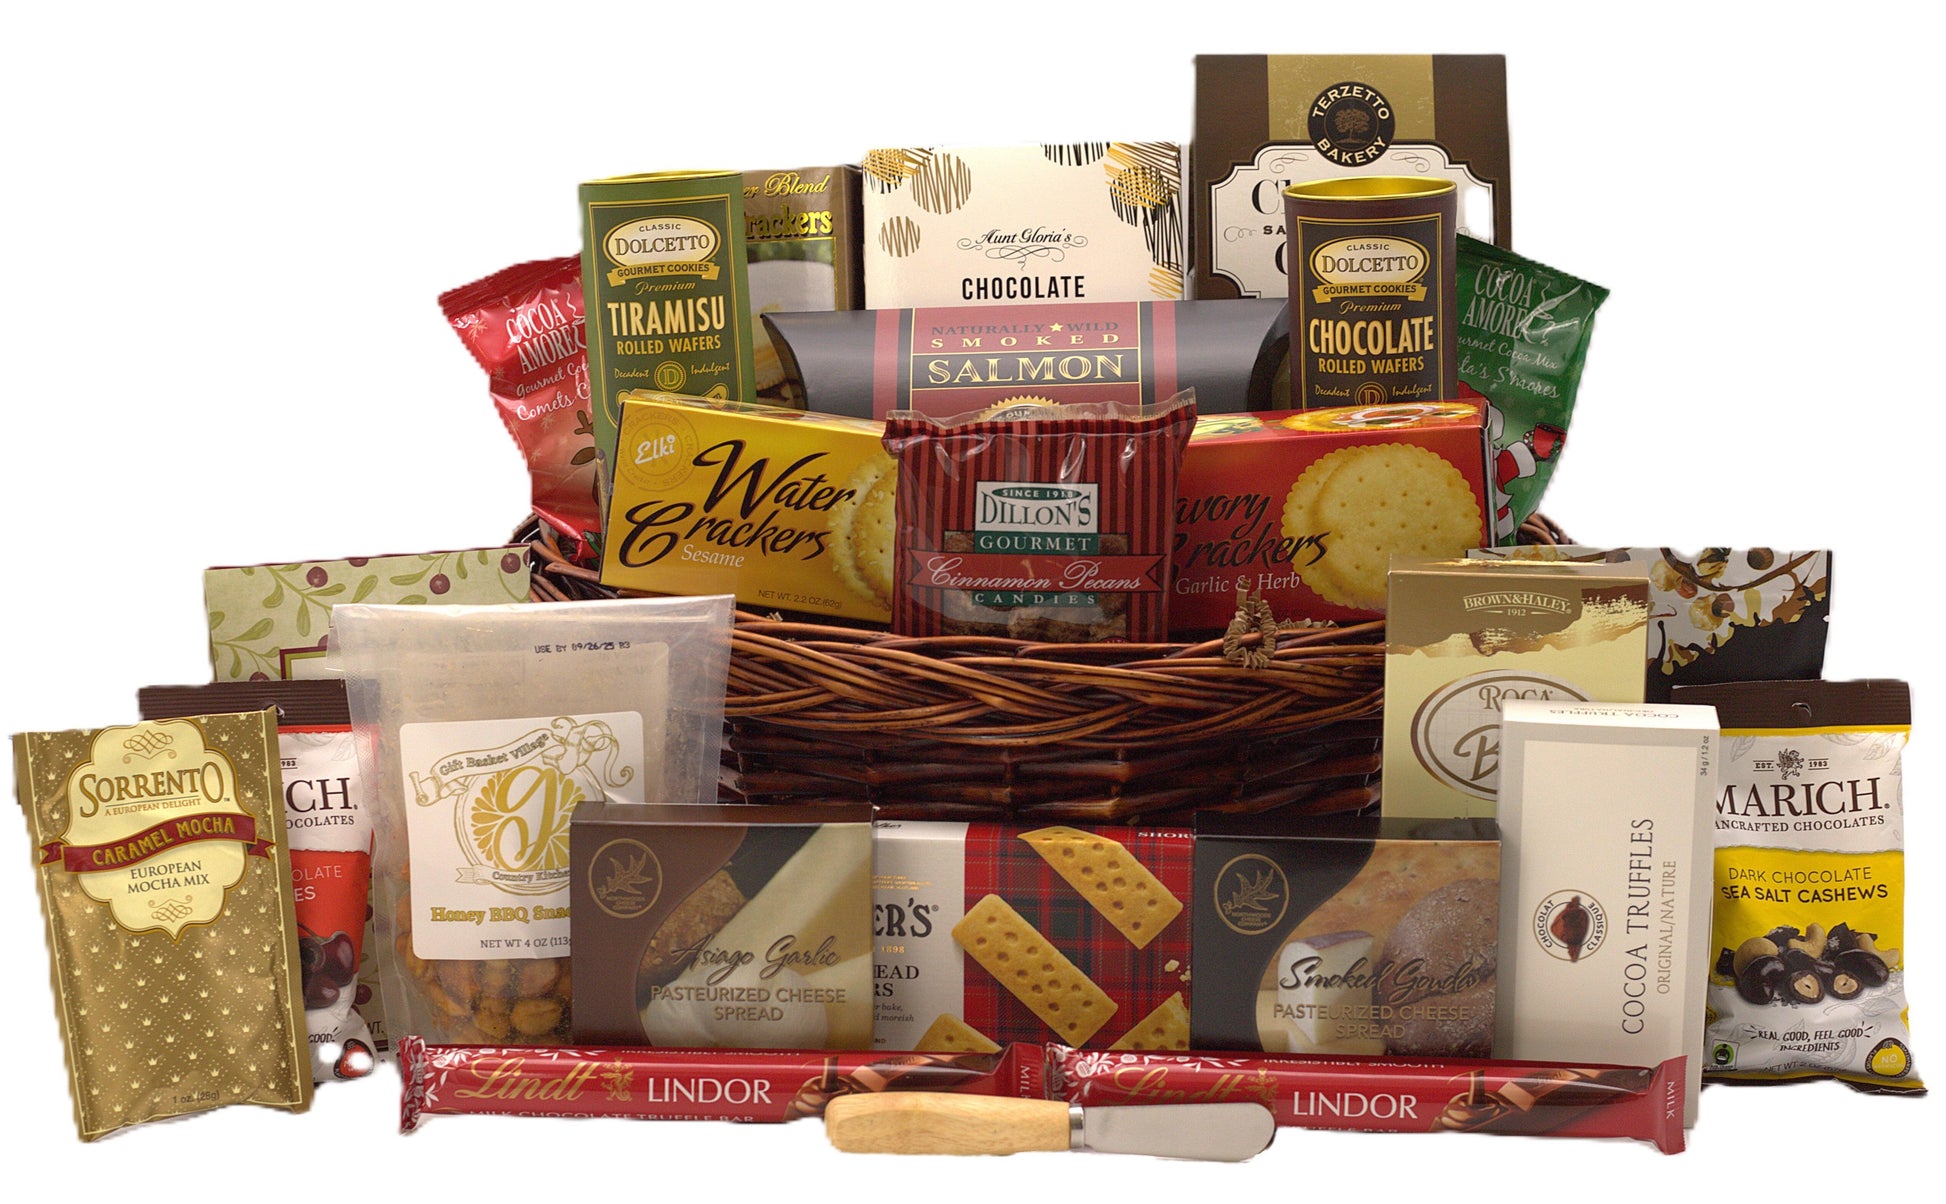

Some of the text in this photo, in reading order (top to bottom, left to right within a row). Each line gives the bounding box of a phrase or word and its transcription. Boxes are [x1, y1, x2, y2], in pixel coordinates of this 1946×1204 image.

[1312, 85, 1390, 121] TERZETTO
[1317, 136, 1387, 164] BAKERY
[764, 172, 831, 196] Blend
[639, 223, 682, 232] CLASSIC
[744, 203, 833, 238] rackers
[615, 234, 710, 256] DOLCETTO
[975, 226, 1072, 245] Aunt Gloria's
[1346, 243, 1390, 252] CLASSIC
[617, 263, 710, 278] GOURMET COOKIES
[1322, 255, 1418, 274] DOLCETTO
[635, 281, 696, 296] Premium
[962, 276, 1085, 300] CHOCOLATE
[1323, 284, 1417, 295] GOURMET COOKIES
[1474, 264, 1534, 308] COCOA
[607, 296, 725, 337] TIRAMISU
[1339, 300, 1402, 315] Premium
[1462, 296, 1529, 340] AMORE
[506, 299, 567, 340] COCOA
[932, 321, 1119, 336] NATURALLY WILD
[617, 335, 722, 355] ROLLED WAFERS
[930, 333, 1119, 348] SMOKED
[1309, 315, 1435, 356] CHOCOLATE
[518, 324, 579, 374] AMORE
[614, 368, 650, 379] Decadent
[691, 362, 730, 376] Indulgent
[928, 354, 1124, 384] SALMON
[1318, 356, 1425, 375] ROLLED WAFERS
[516, 368, 566, 399] Gourmet
[1314, 384, 1350, 397] Decadent
[1392, 384, 1432, 398] Indulgent
[516, 392, 576, 421] Comets
[635, 434, 676, 465] Elki
[692, 439, 857, 520] Water
[1002, 488, 1040, 498] SINCE
[980, 491, 1092, 527] DILLON'S
[1175, 493, 1271, 541] avory
[619, 499, 833, 568] Crackers
[979, 535, 1092, 551] GOURMET
[681, 544, 745, 568] Sesame
[927, 556, 1142, 590] Cinnamon Pecans
[1176, 575, 1229, 595] Garlic
[1257, 571, 1300, 591] Herb
[758, 589, 774, 599] NET
[777, 592, 790, 601] WT.
[793, 594, 807, 604] 2.2
[975, 593, 1096, 605] CANDIES
[1507, 608, 1527, 616] 1912
[439, 733, 549, 776] Gift Basket Village
[1809, 760, 1828, 768] 1983
[79, 761, 224, 818] SORRENTO
[1716, 777, 1881, 817] MARICH
[104, 799, 202, 817] A EUROPEAN DELIGHT
[286, 815, 355, 830] OCOLATES
[1715, 815, 1885, 832] ANCRAFTED CHOCOLATES
[92, 817, 236, 866] CARAMEL MOCHA
[130, 861, 202, 880] EUROPEAN
[291, 865, 342, 882] OLATE
[492, 871, 534, 884] Country
[1729, 866, 1872, 884] DARK CHOCOLATE
[127, 873, 210, 895] MOCHA MIX
[1721, 884, 1888, 903] SEA SALT CASHEWS
[431, 906, 486, 925] Honey
[489, 906, 530, 924] BBQ
[1538, 899, 1554, 949] CHOCOLAT
[1586, 901, 1604, 951] CLASSIQUE
[1621, 818, 1654, 1035] COCOA TRUFFLES
[1656, 860, 1677, 995] ORIGINAL/NATURE
[480, 939, 502, 948] NET
[504, 939, 522, 948] WT
[524, 939, 531, 948] 4
[533, 938, 548, 948] OZ
[671, 934, 841, 986] Asiago Garlic
[1279, 956, 1480, 1009] Smoked Gouda
[651, 986, 846, 1003] PASTEURIZED CHEESE
[714, 1006, 783, 1021] SPREAD
[1273, 1004, 1470, 1021] PASTEURIZED CHEESE
[1335, 1024, 1405, 1039] SPREAD
[1757, 1028, 1864, 1042] REAL GOOD, FEEL GOOD
[1779, 1042, 1841, 1052] INGREDIENTS
[454, 1057, 601, 1101] Lindt
[648, 1078, 772, 1106] LINDOR
[1665, 1081, 1676, 1120] MILK
[1292, 1091, 1418, 1120] LINDOR
